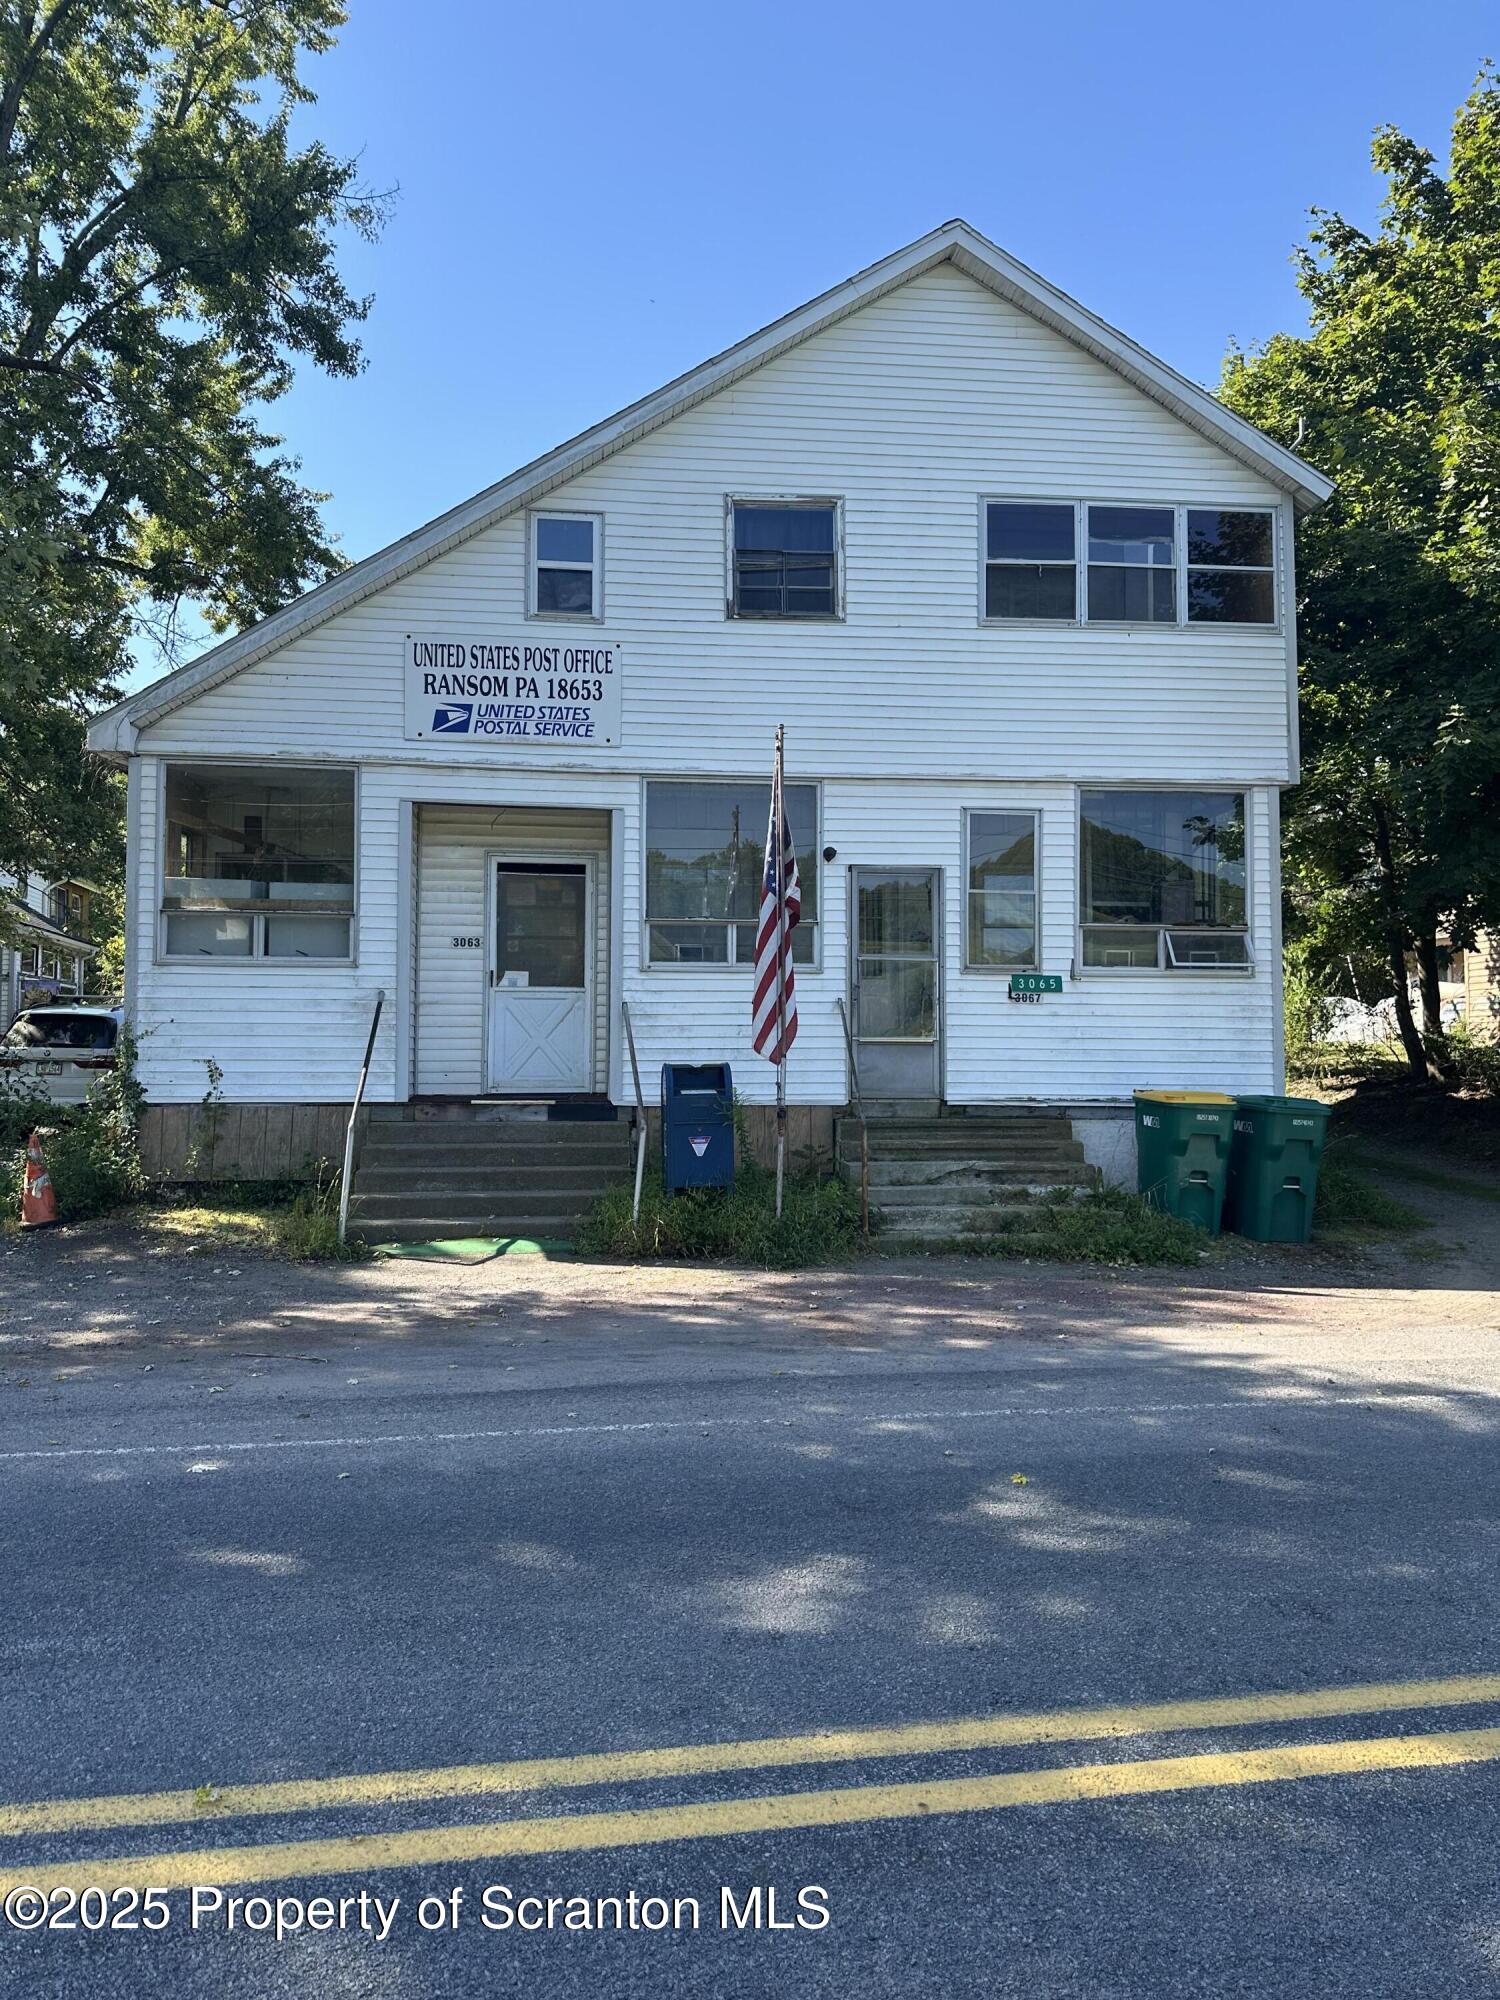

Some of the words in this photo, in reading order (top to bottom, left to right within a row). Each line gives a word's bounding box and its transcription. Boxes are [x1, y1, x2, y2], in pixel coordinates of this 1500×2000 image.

[413, 642, 466, 668] UNITED
[470, 644, 520, 671] STATES
[524, 646, 560, 673] POST
[563, 648, 613, 674] OFFICE
[423, 673, 509, 698] RANSOM
[515, 676, 540, 699] PA
[547, 678, 603, 701] 18653
[477, 703, 535, 719] UNITED
[537, 705, 591, 721] STATES
[474, 720, 531, 735] POSTAL
[534, 722, 595, 738] SERVICE
[453, 937, 480, 948] 3063
[1018, 978, 1056, 989] 3065
[1014, 993, 1041, 1003] 3067
